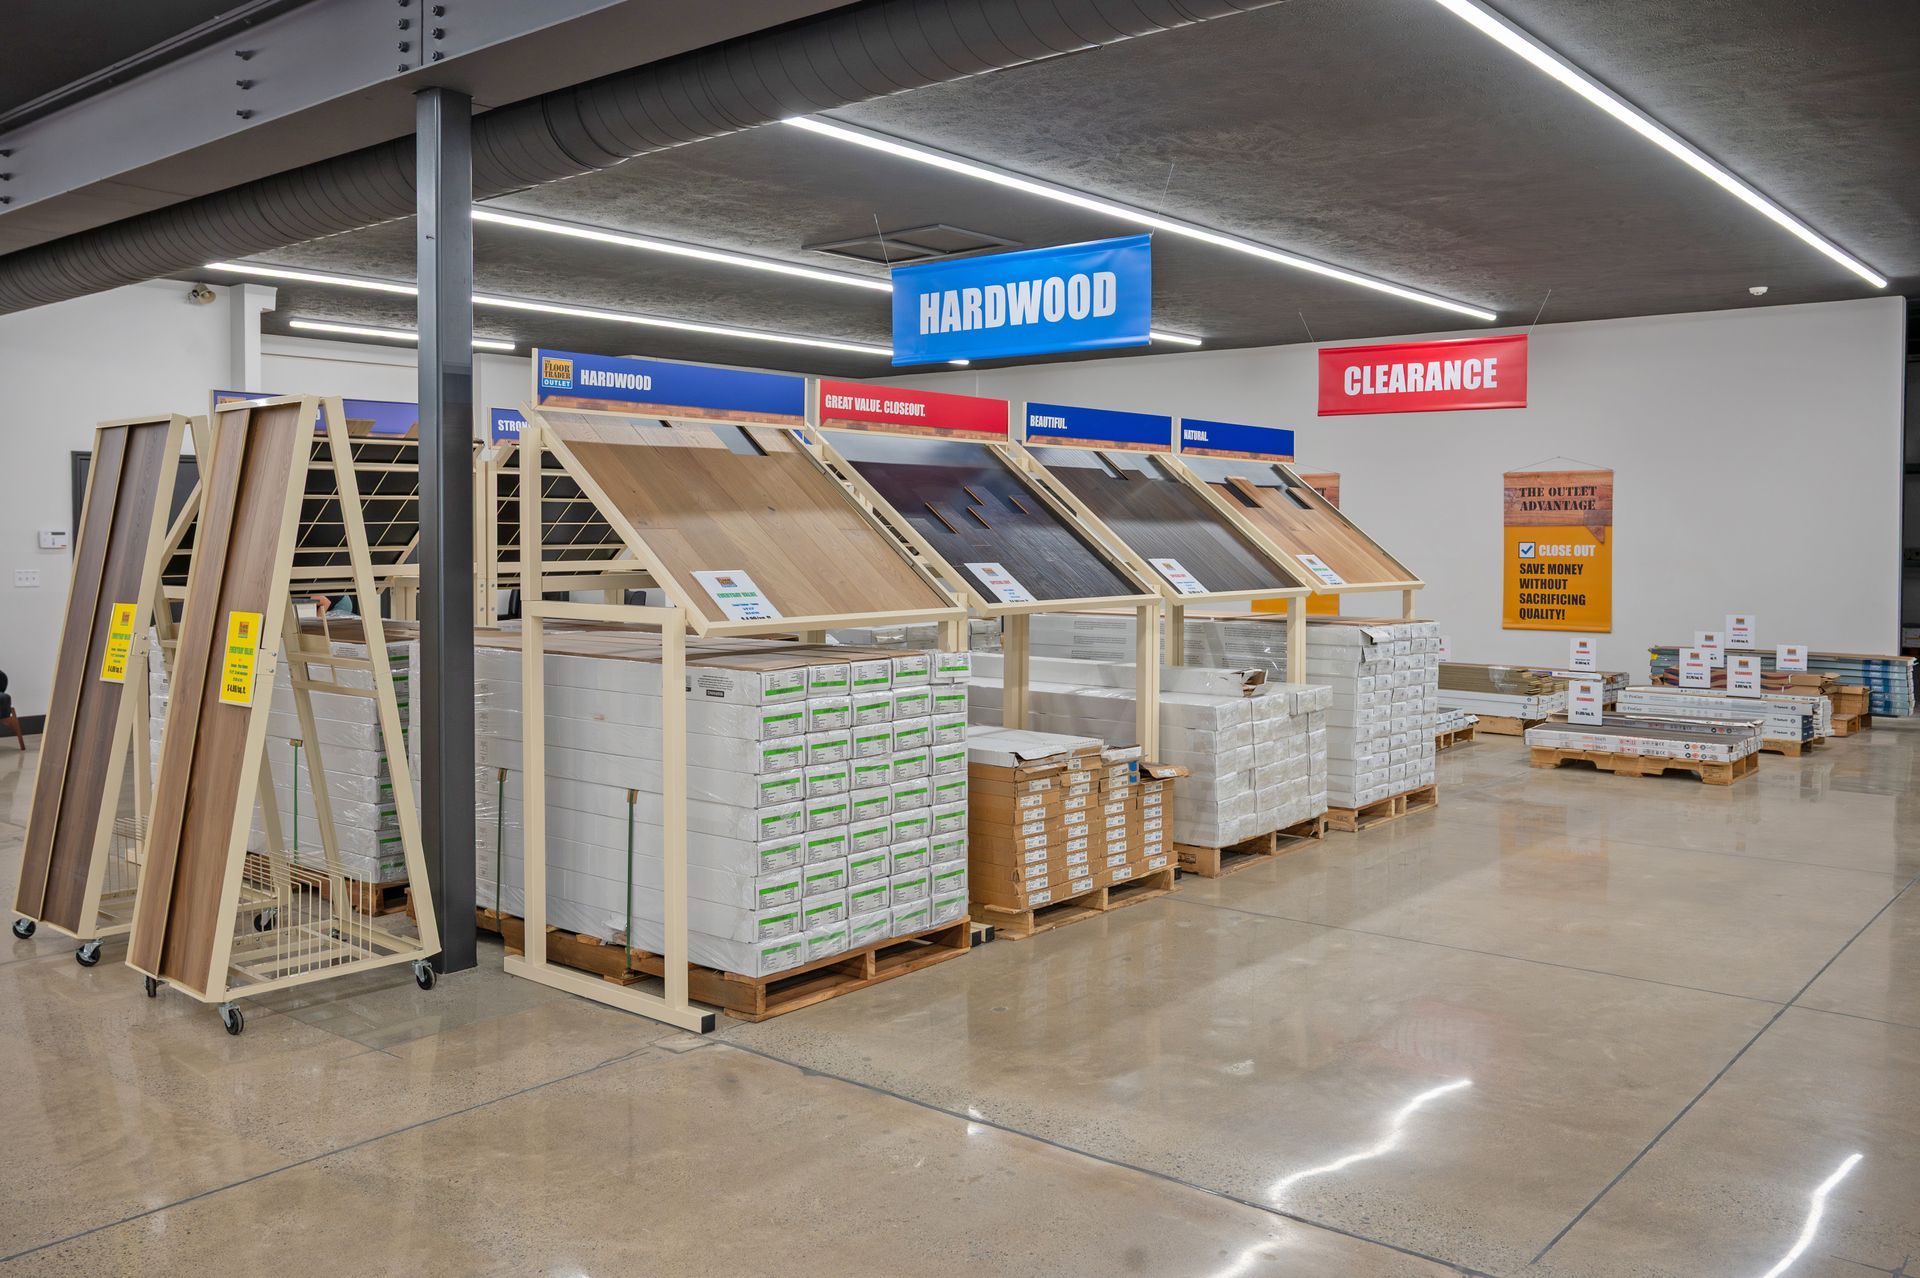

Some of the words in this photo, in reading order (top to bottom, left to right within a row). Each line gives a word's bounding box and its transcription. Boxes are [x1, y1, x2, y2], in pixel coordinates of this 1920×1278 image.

[920, 271, 1116, 335] HARDWOOD
[544, 363, 570, 372] FLOOR
[544, 371, 571, 379] TRADER
[580, 369, 652, 391] HARDWOOD
[1344, 358, 1498, 396] CLEARANCE
[544, 379, 571, 387] OUTLET
[825, 394, 853, 410] GREAT
[884, 401, 926, 417] CLOSEOUT.
[1030, 415, 1067, 429] BEAUTIFUL.
[1184, 429, 1208, 441] NATURAL.
[1519, 487, 1544, 498] THE
[1548, 486, 1597, 497] OUTLET
[1520, 499, 1596, 511] ADVANTAGE
[1538, 545, 1572, 557] CLOSE
[1574, 545, 1596, 557] OUT
[1519, 563, 1545, 575] SAVE
[1547, 563, 1584, 575] MONEY
[1519, 578, 1568, 590] WITHOUT
[1519, 593, 1586, 606] SACRIFICING
[1519, 607, 1565, 620] QUALITY!
